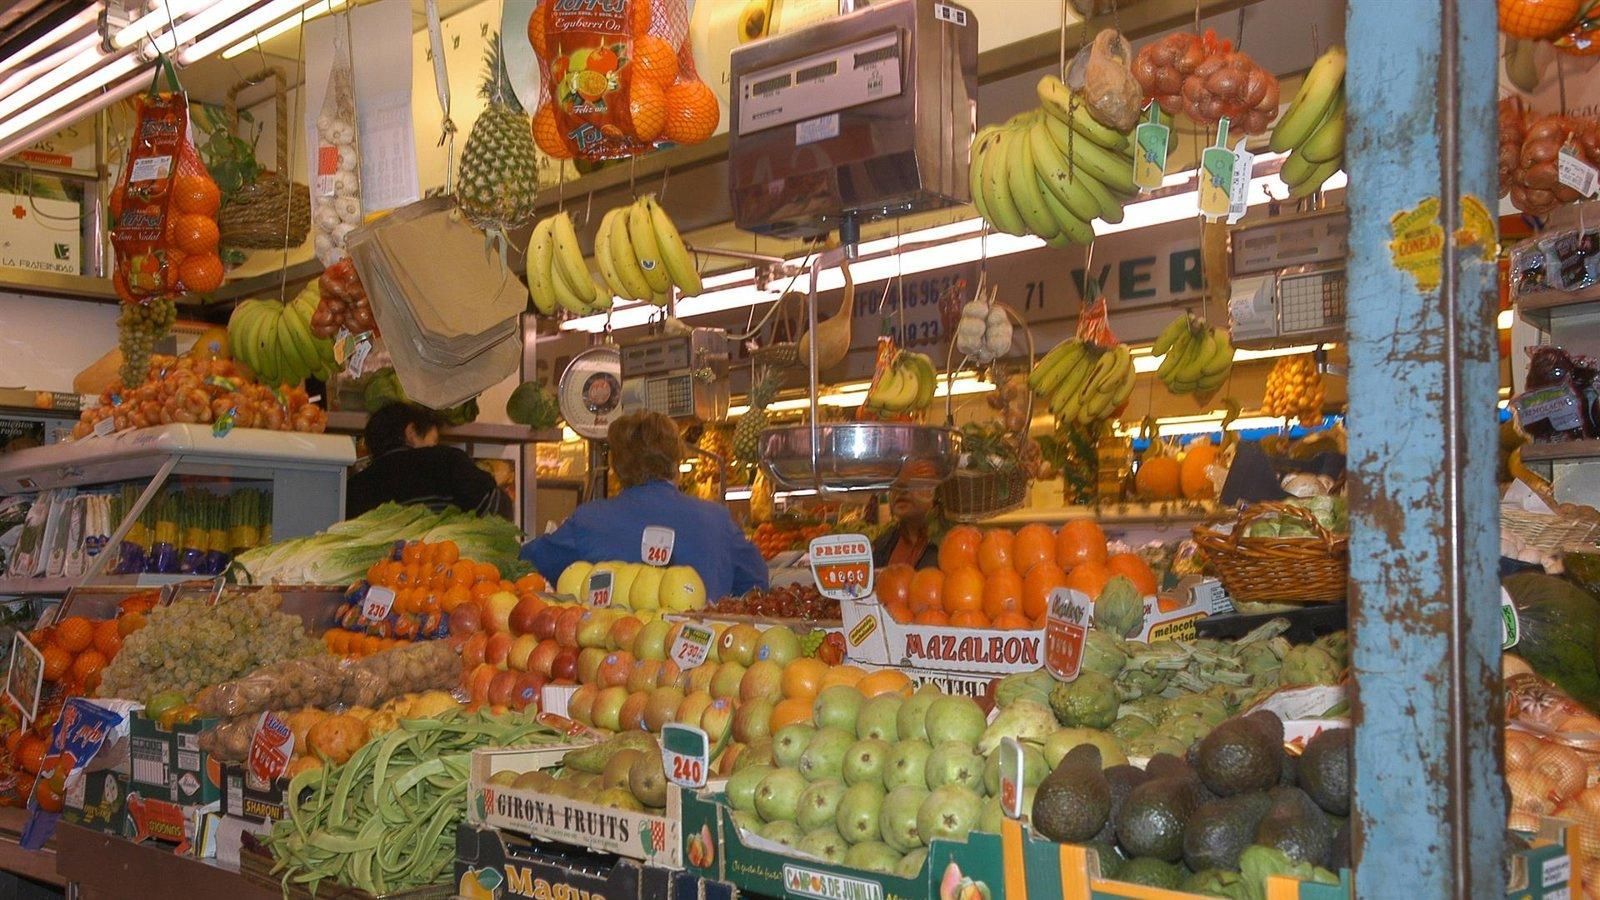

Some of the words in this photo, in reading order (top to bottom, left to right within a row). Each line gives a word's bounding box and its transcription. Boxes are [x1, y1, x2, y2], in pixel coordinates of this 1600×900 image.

[605, 19, 622, 31] On
[2, 257, 16, 267] LA
[648, 546, 668, 562] 240
[815, 543, 866, 557] PRECIO
[593, 590, 609, 606] 230
[367, 603, 386, 618] 230
[905, 632, 1041, 665] MAZALEON
[673, 755, 702, 784] 240
[246, 800, 281, 818] SHARONI
[497, 793, 556, 828] GIRONA
[563, 806, 630, 843] FRUITS
